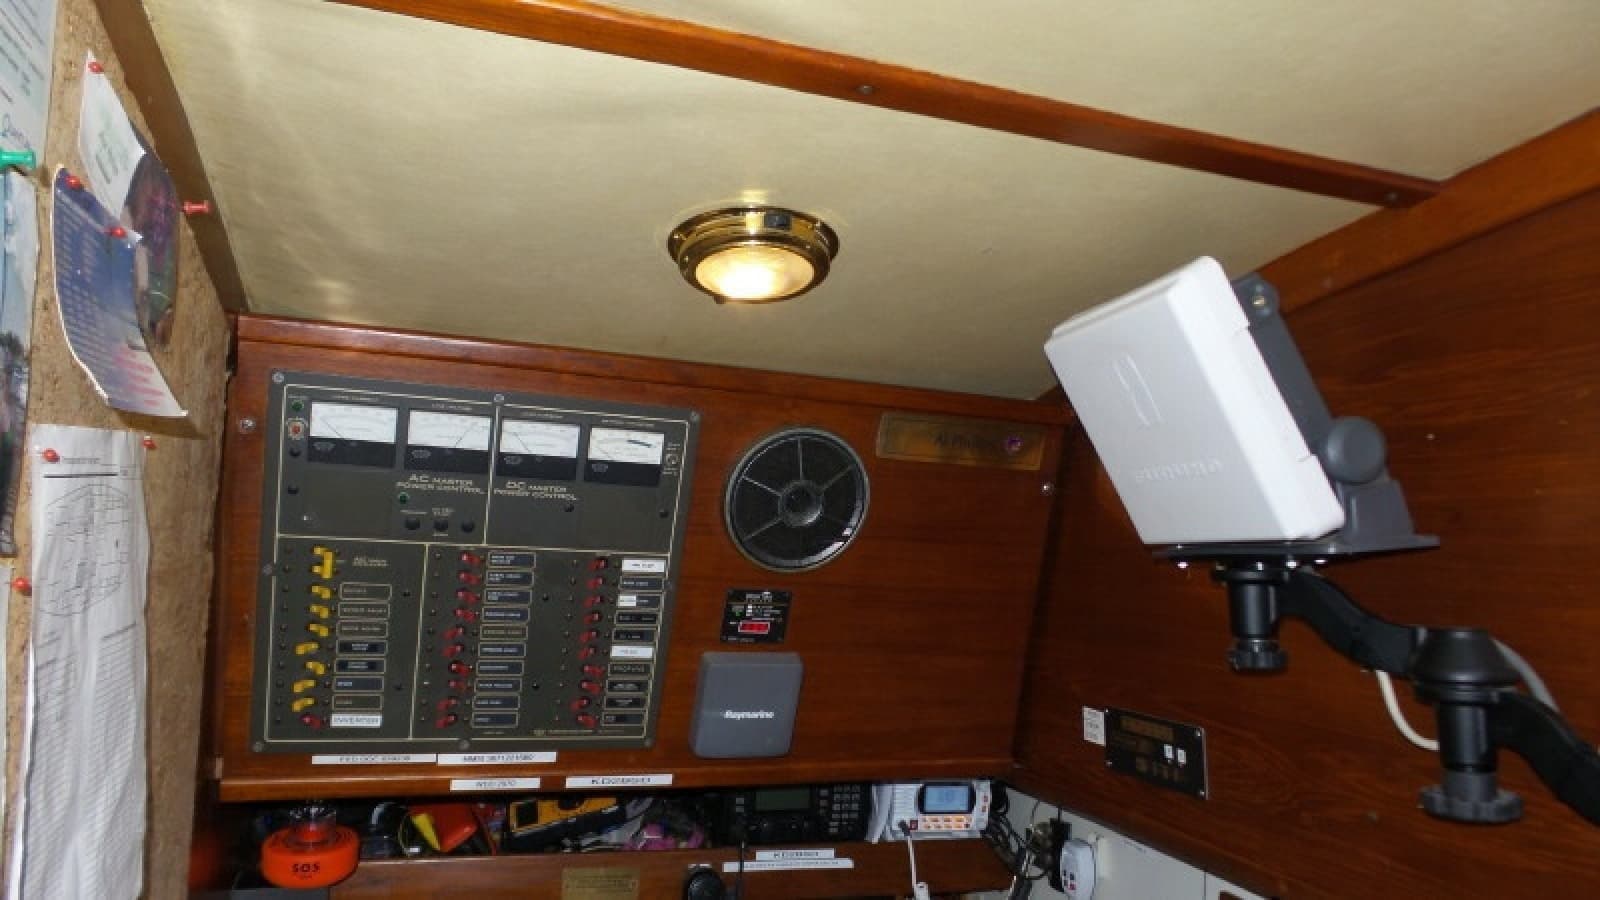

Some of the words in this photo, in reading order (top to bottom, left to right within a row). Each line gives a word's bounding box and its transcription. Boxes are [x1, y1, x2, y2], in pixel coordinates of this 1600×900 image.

[409, 473, 429, 482] AC
[432, 477, 473, 487] MASTER
[506, 480, 526, 490] DC
[527, 485, 567, 493] MASTER
[395, 481, 434, 490] POWER
[434, 483, 487, 495] CONTROL
[493, 487, 530, 496] POWER
[531, 490, 577, 501] CONTROL
[723, 709, 775, 721] Raymarine
[291, 862, 321, 873] SOS
